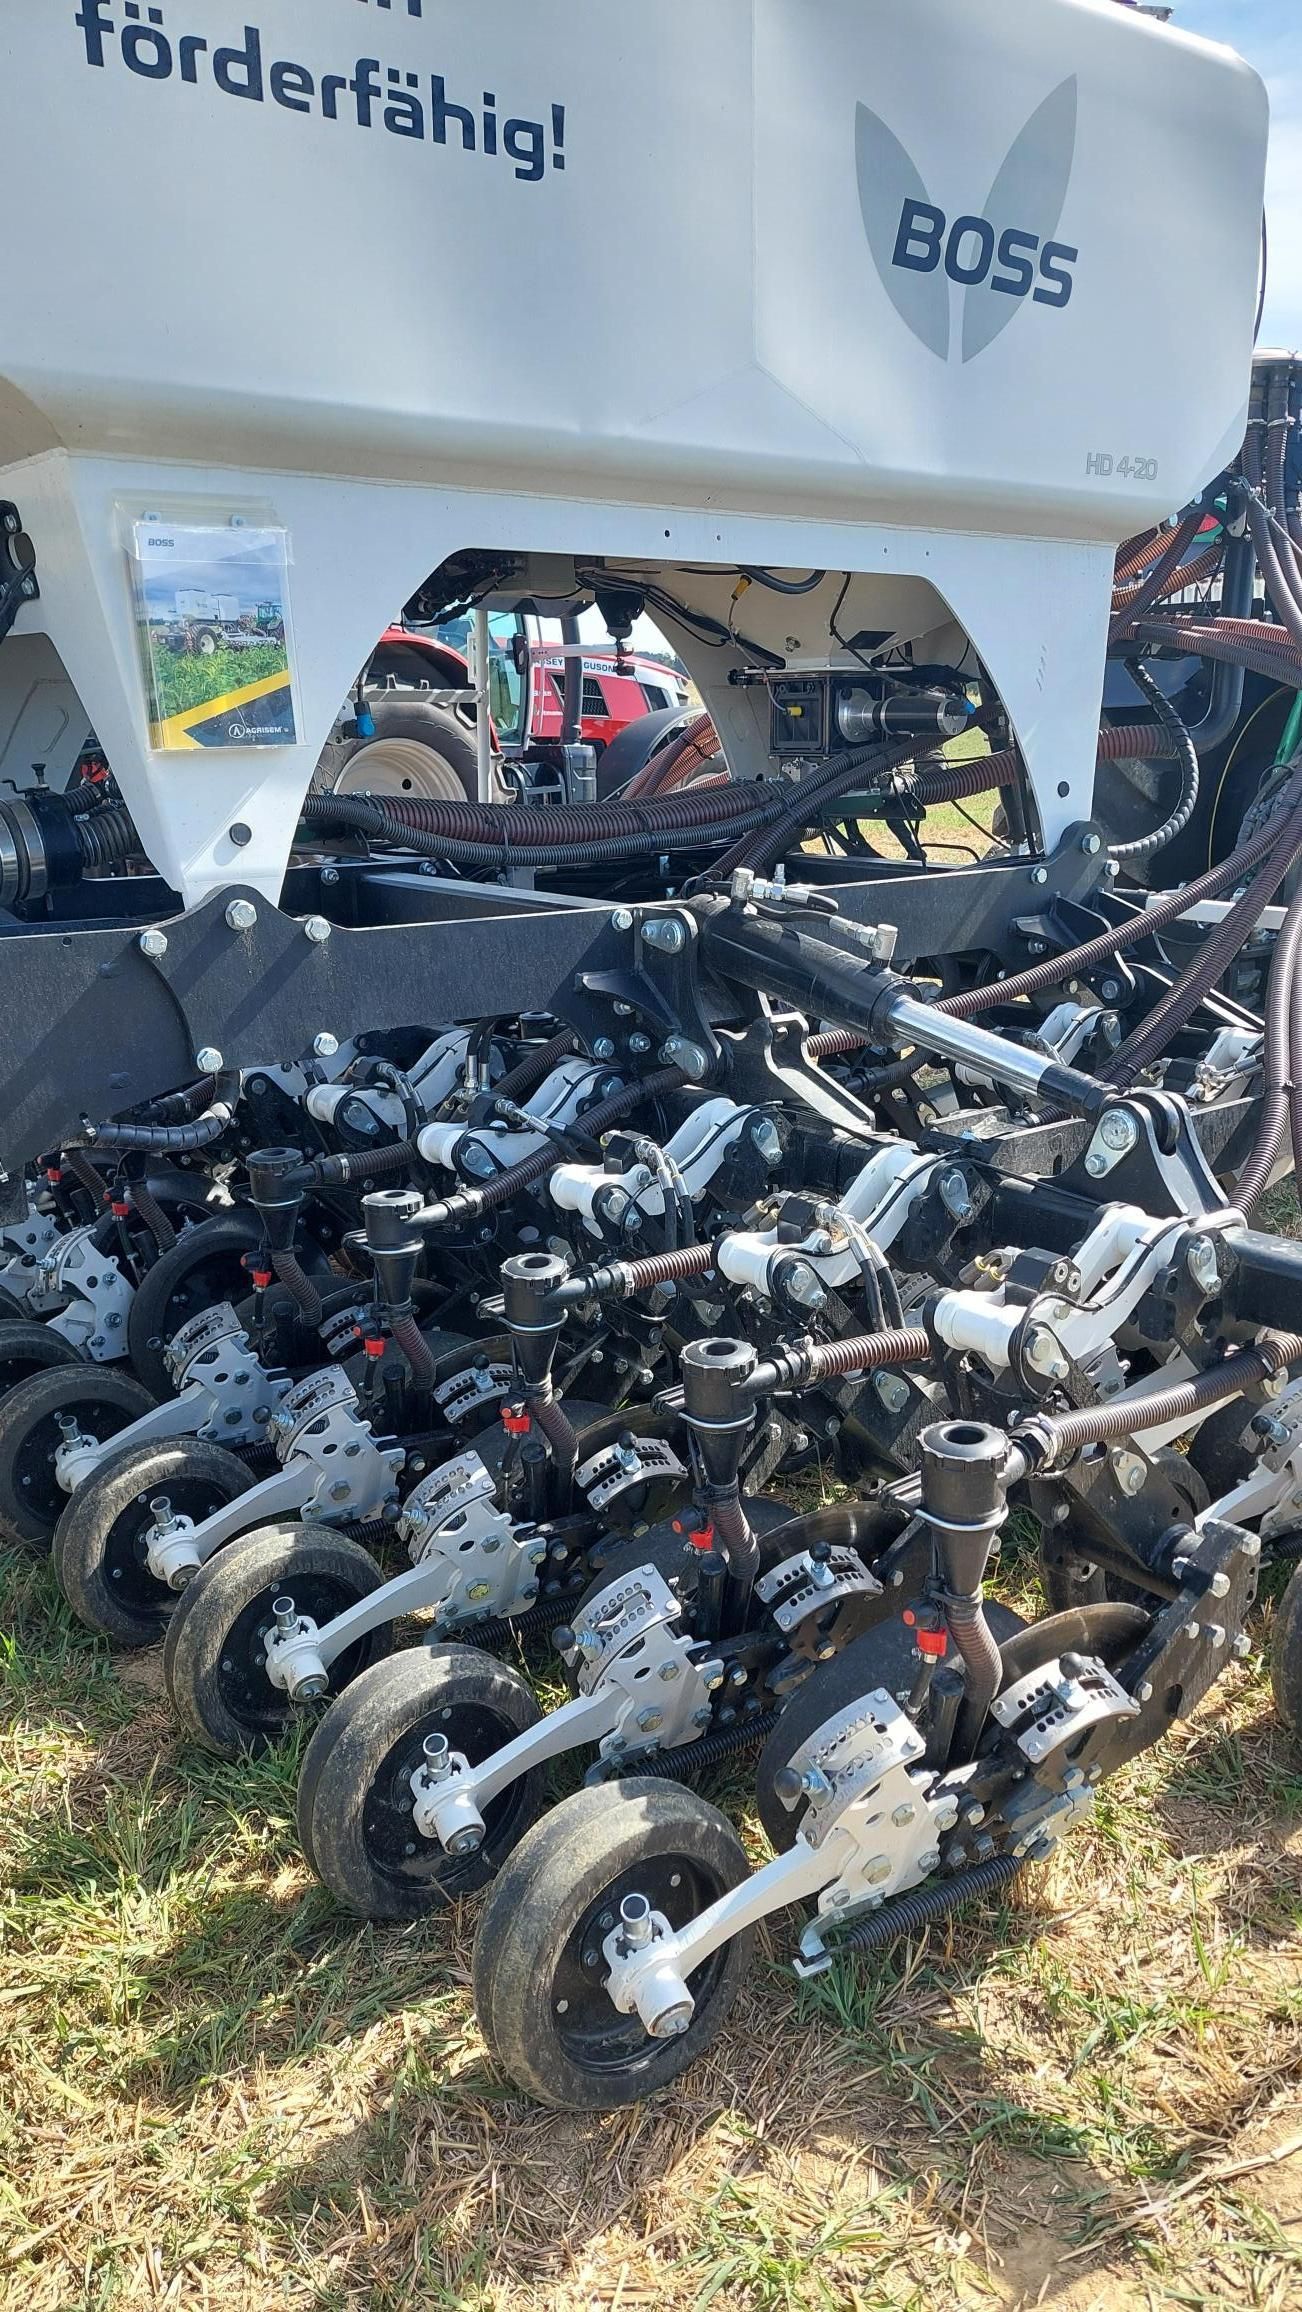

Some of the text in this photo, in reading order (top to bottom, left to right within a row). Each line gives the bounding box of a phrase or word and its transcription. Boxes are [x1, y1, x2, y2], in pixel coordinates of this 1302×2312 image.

[75, 0, 566, 182] förderfähig!
[891, 197, 1079, 308] BOSS
[1085, 452, 1158, 481] HD 4-20
[148, 537, 175, 547] BOSS
[583, 661, 615, 672] GUSON
[245, 726, 282, 734] AGRISEM
